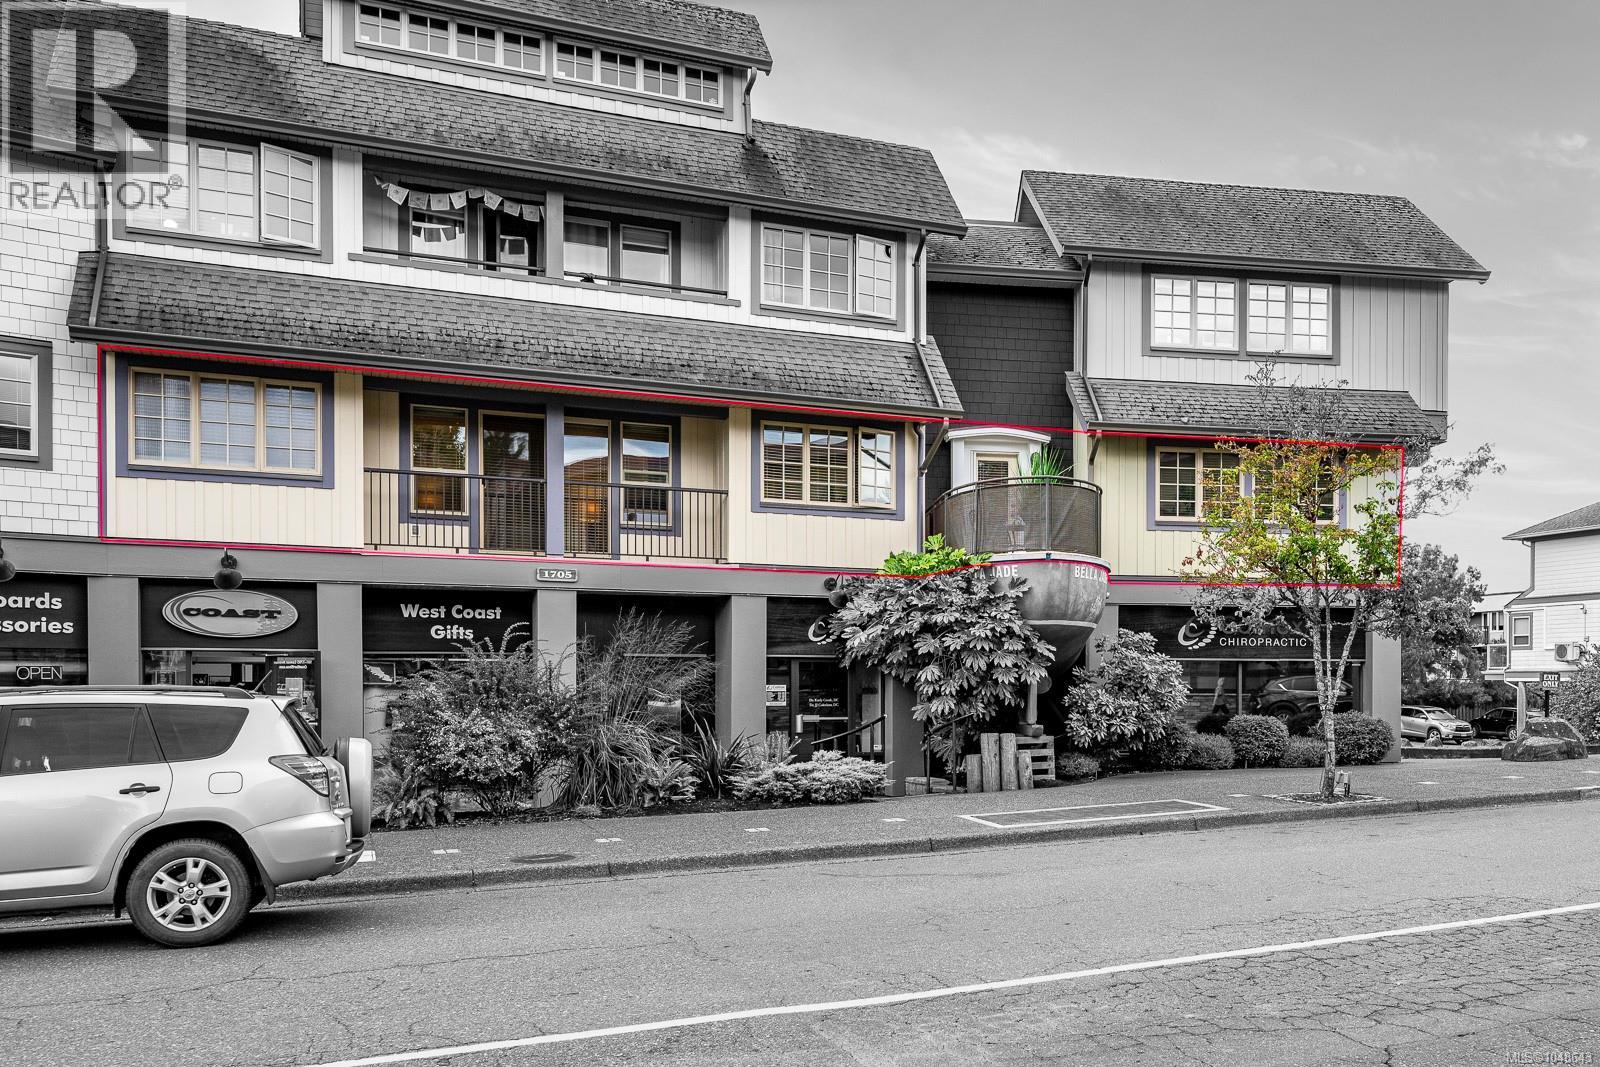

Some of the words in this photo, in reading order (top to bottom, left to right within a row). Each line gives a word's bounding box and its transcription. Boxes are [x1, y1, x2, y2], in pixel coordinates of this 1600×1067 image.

[543, 570, 573, 579] 1705
[990, 565, 1018, 578] JADE
[1075, 565, 1098, 580] BELLA
[182, 607, 282, 619] COAST
[400, 603, 447, 619] West
[451, 604, 502, 620] Coast
[0, 616, 75, 634] sories
[430, 624, 474, 640] Gifts
[1219, 637, 1307, 647] CHIROPRACTIC
[16, 666, 63, 680] OPEN
